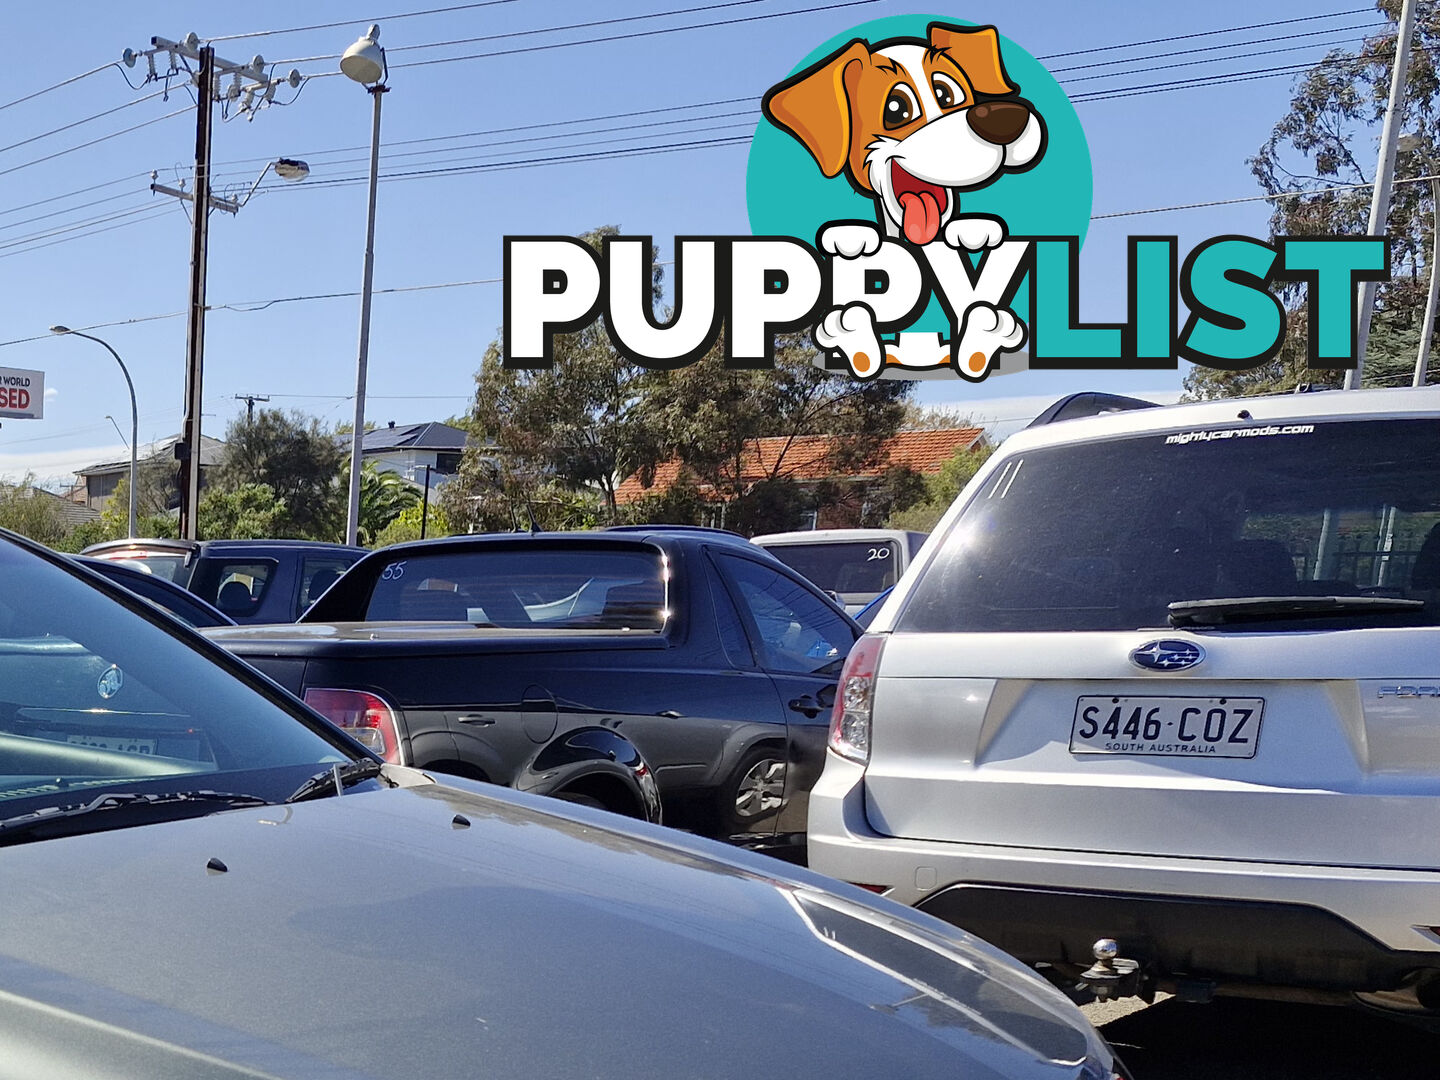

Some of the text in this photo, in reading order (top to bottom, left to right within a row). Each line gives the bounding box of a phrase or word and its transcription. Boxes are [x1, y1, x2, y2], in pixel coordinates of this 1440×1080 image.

[3, 376, 31, 388] WORLD
[1164, 425, 1315, 445] mightycarmods.com
[866, 547, 890, 562] 20
[382, 560, 408, 580] 55
[1378, 685, 1440, 699] FOR
[1105, 742, 1216, 754] SOUTH AUSTRALIA
